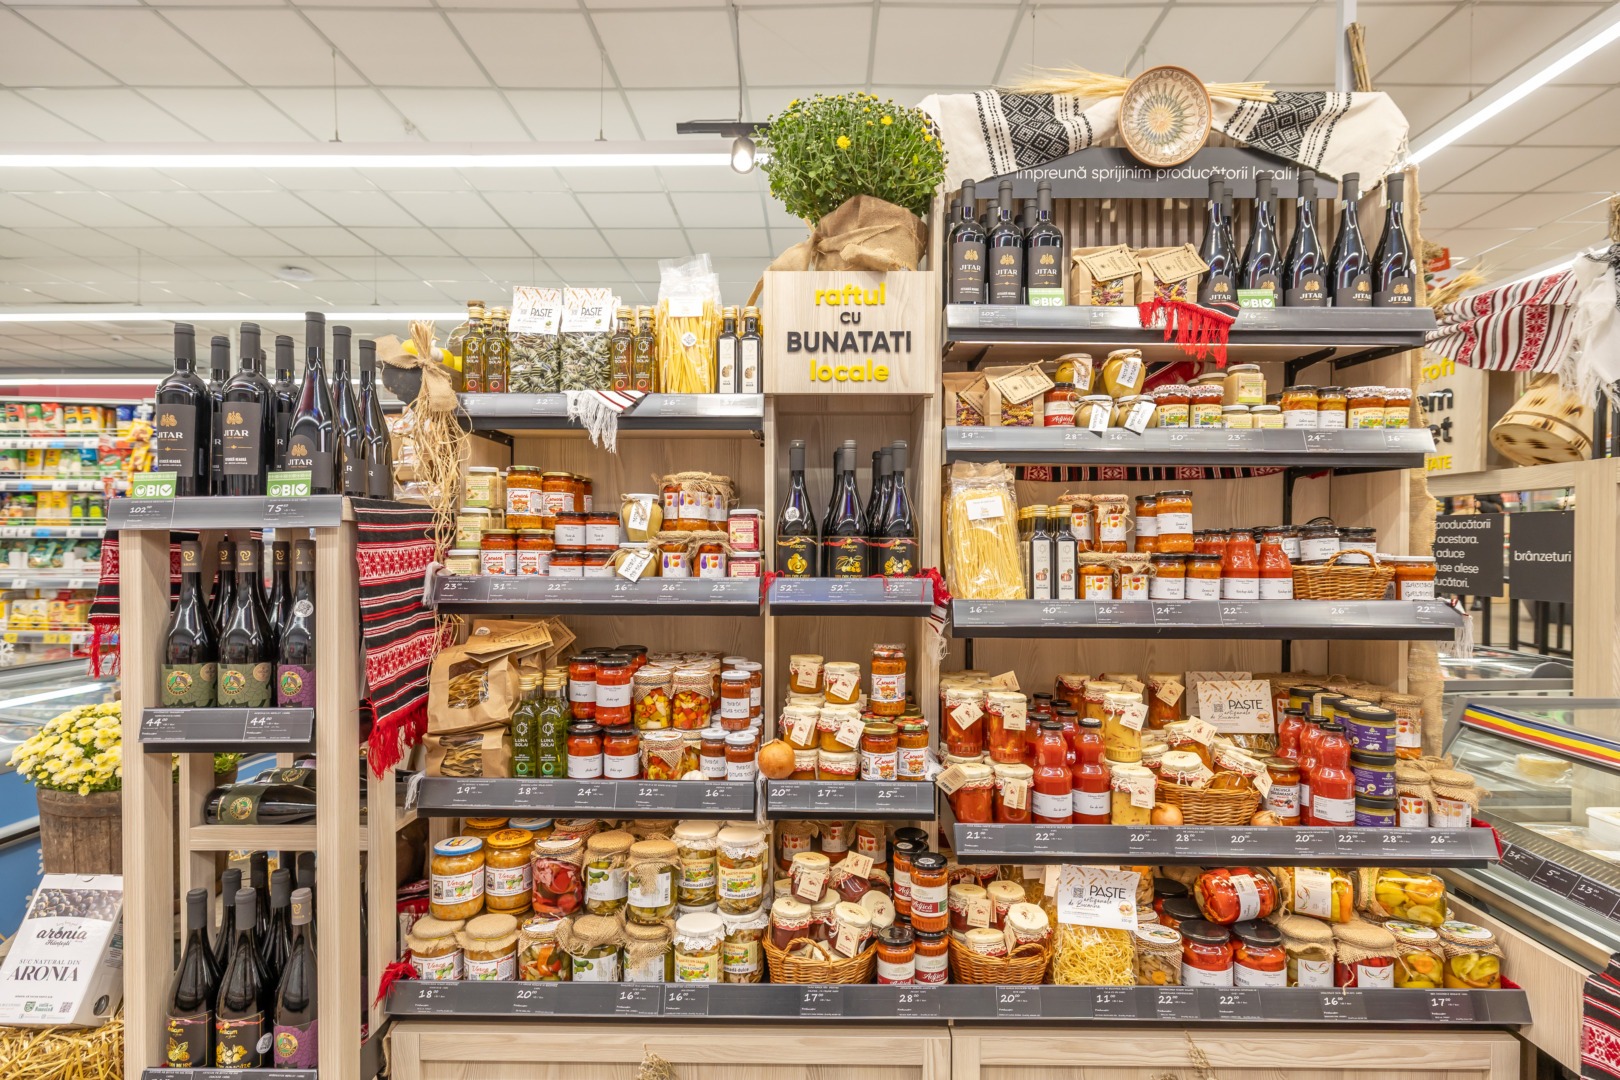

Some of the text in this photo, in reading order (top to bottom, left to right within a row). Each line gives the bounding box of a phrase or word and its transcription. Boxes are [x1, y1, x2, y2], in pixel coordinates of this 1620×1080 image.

[1091, 166, 1151, 182] sprijinim
[814, 282, 886, 306] raftul
[840, 311, 861, 324] CU
[786, 330, 912, 354] BUNATATI
[810, 359, 890, 382] locale
[158, 431, 183, 439] JITAR
[288, 458, 313, 466] JITAR
[1437, 535, 1480, 544] acestora.
[1436, 548, 1466, 558] aduce
[1514, 550, 1572, 562] brânzeturi
[1454, 563, 1479, 574] alese
[146, 718, 162, 726] 44
[250, 717, 265, 726] 44
[818, 789, 831, 797] 17
[1130, 834, 1144, 842] 20
[1176, 834, 1189, 842] 28
[1231, 835, 1244, 843] 20
[1338, 835, 1353, 843] 22
[1430, 836, 1445, 844] 26
[1508, 851, 1520, 860] 34
[898, 886, 911, 895] Adj
[1577, 884, 1592, 894] 13
[36, 926, 87, 940] aronia
[6, 966, 78, 982] ARONIA
[418, 990, 432, 998] 18
[517, 990, 532, 998] 20
[620, 991, 634, 1000] 16
[669, 993, 682, 1001] 16
[804, 993, 818, 1002] 17
[899, 994, 913, 1003] 28
[1000, 994, 1015, 1003] 20
[1096, 994, 1110, 1003] 11
[1158, 996, 1173, 1004] 22
[1220, 996, 1234, 1005] 22
[1324, 997, 1338, 1006] 16
[1431, 998, 1445, 1007] 17
